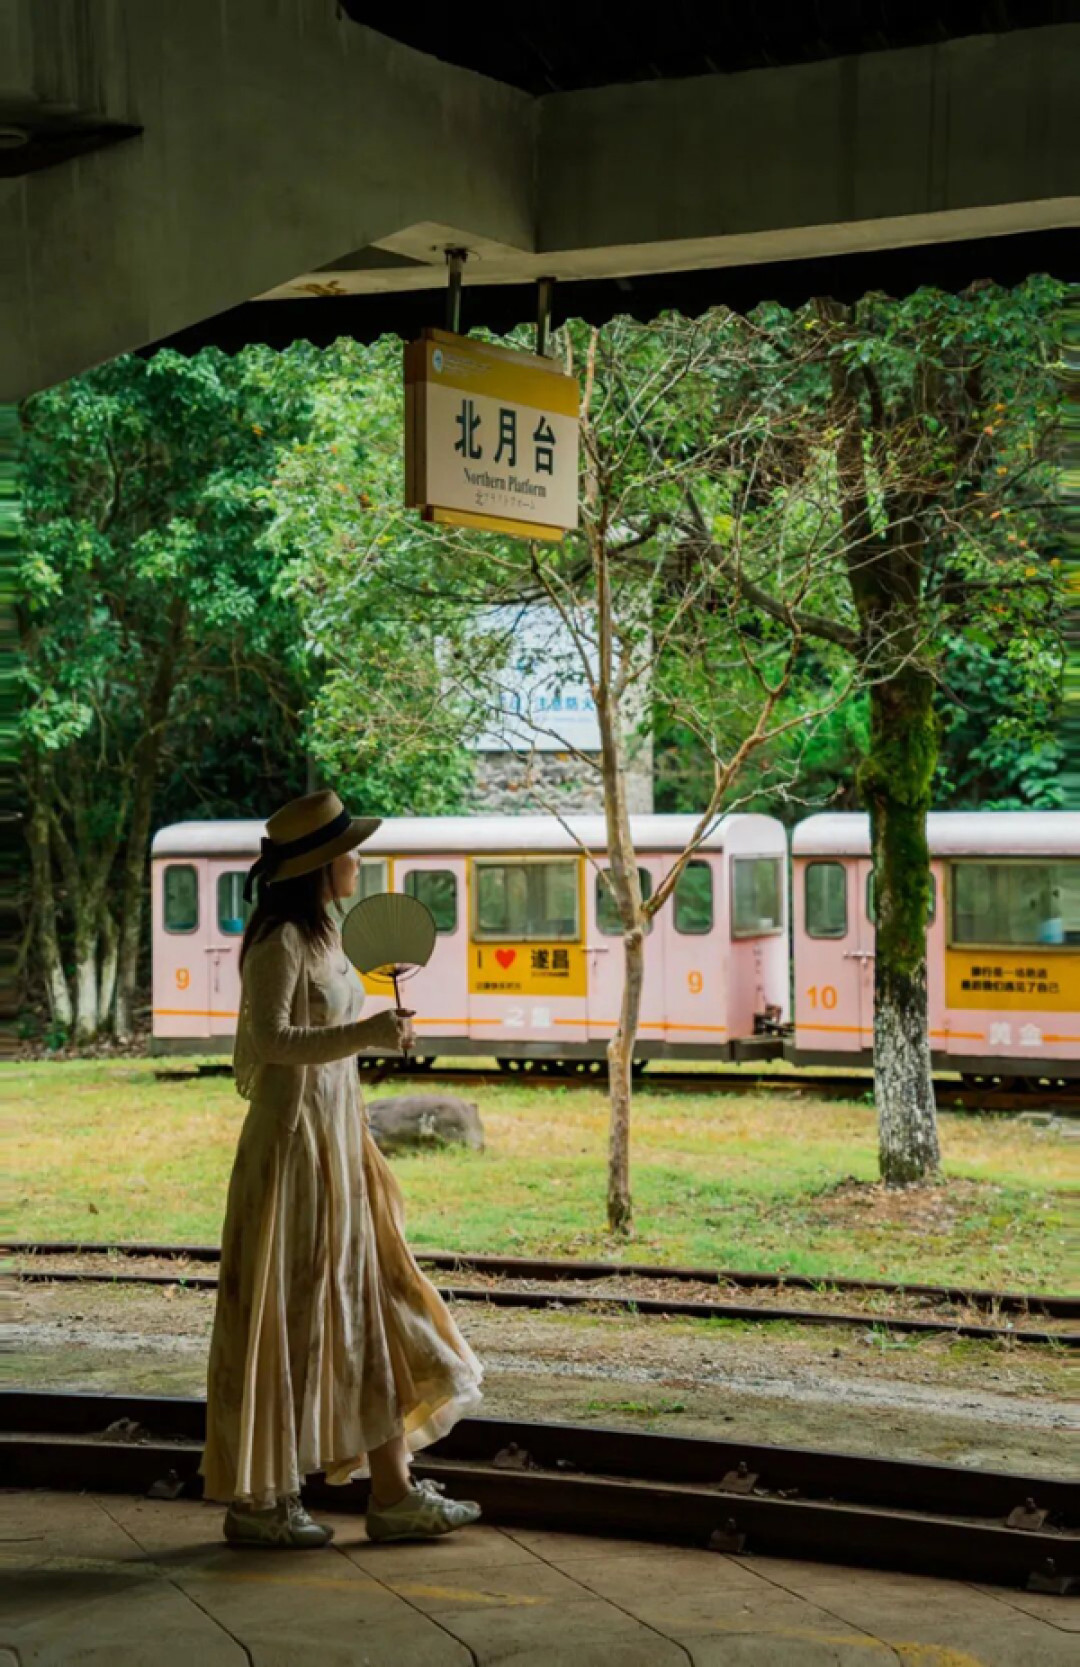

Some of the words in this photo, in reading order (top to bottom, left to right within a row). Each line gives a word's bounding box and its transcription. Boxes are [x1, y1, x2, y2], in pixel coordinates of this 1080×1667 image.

[454, 399, 556, 476] 北月台
[464, 467, 506, 490] Northern
[508, 475, 547, 498] Platform
[477, 949, 482, 969] I
[174, 967, 190, 990] 9
[687, 970, 704, 994] 9
[806, 985, 839, 1010] 10
